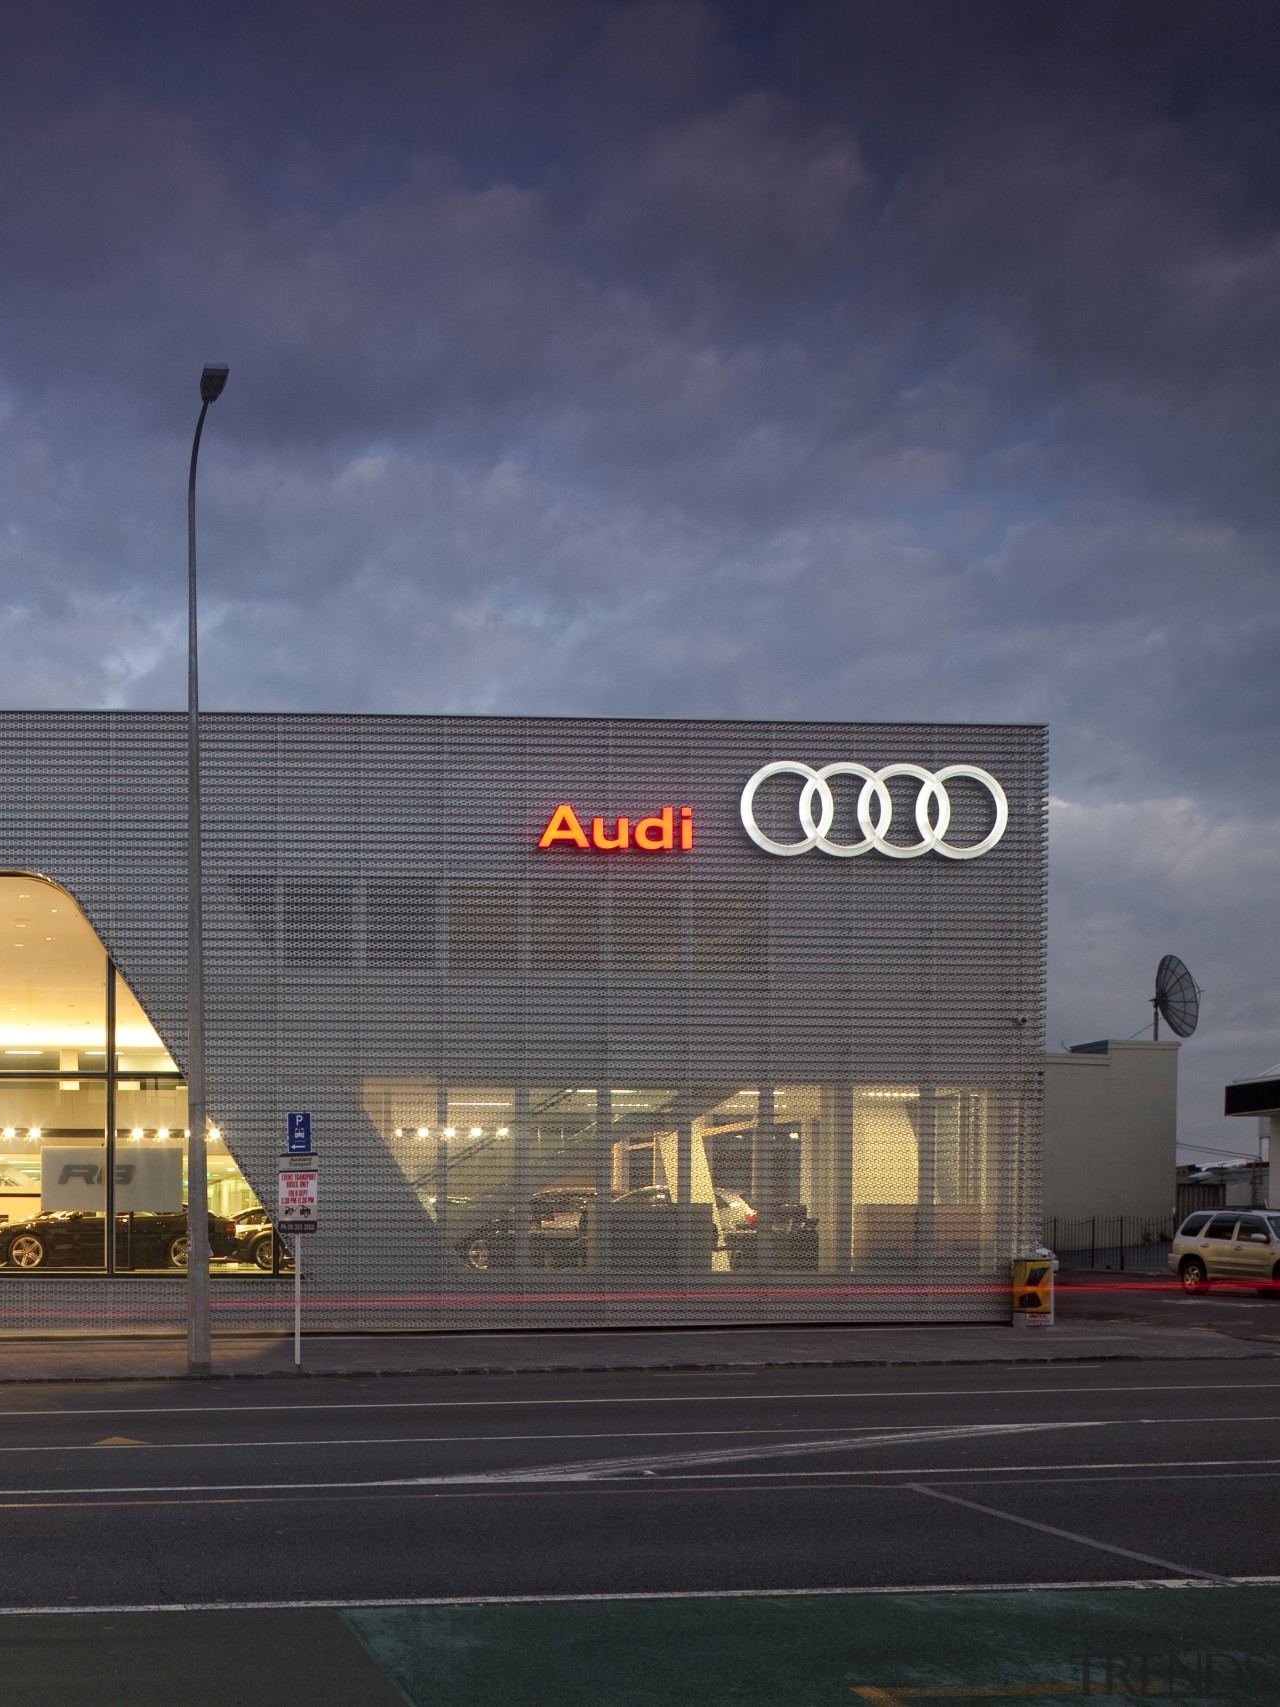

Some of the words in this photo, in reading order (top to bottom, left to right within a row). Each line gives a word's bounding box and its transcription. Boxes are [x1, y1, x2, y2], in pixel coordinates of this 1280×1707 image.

[538, 804, 693, 850] Audi
[296, 1115, 303, 1126] P
[58, 1165, 136, 1185] R8
[294, 1173, 317, 1181] TRANSPORT
[299, 1180, 309, 1188] ONLY
